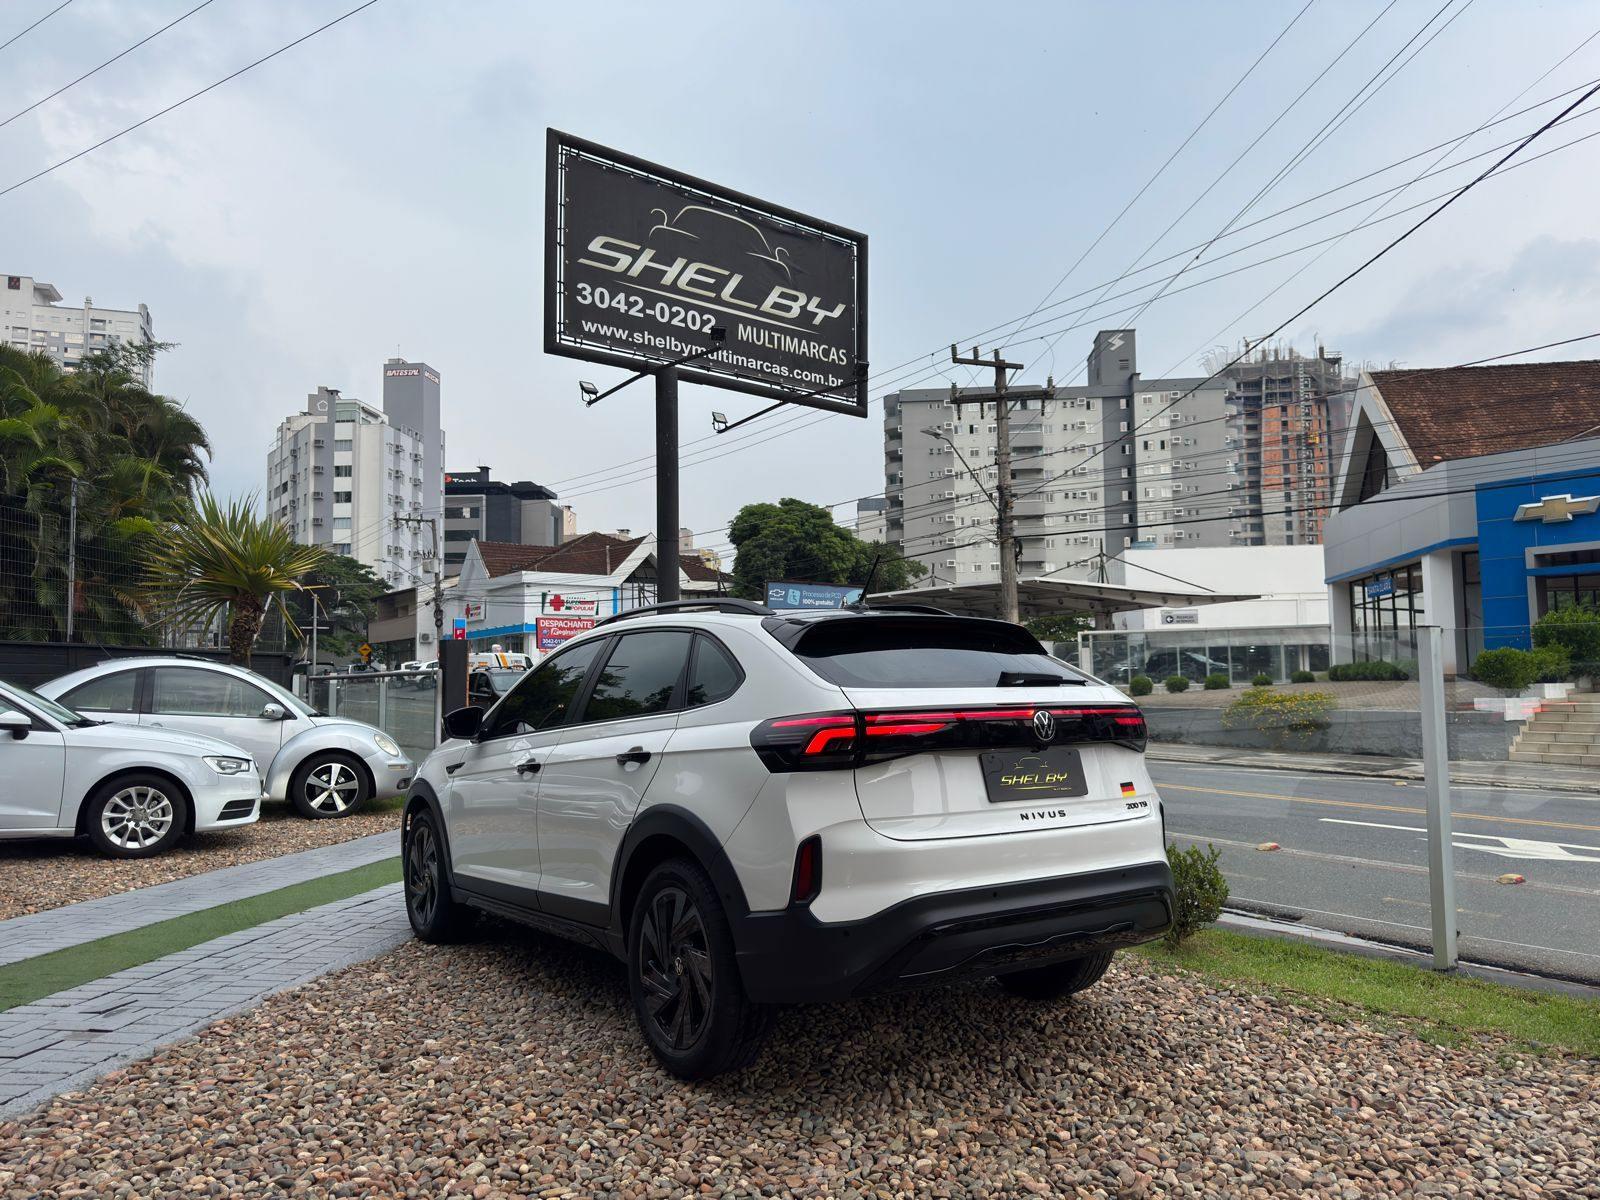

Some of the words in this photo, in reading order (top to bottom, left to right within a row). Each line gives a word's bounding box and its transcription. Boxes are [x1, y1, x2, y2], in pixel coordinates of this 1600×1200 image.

[577, 236, 846, 325] SHELBY
[576, 283, 717, 334] 3042-0202
[582, 319, 844, 387] www.shelbymultimarcas.com.br
[738, 323, 848, 366] MULTIMARCAS
[540, 619, 593, 628] DESPACHANTE
[1000, 772, 1068, 786] SHELBY
[1020, 809, 1067, 821] NIVUS
[1126, 802, 1139, 810] 200
